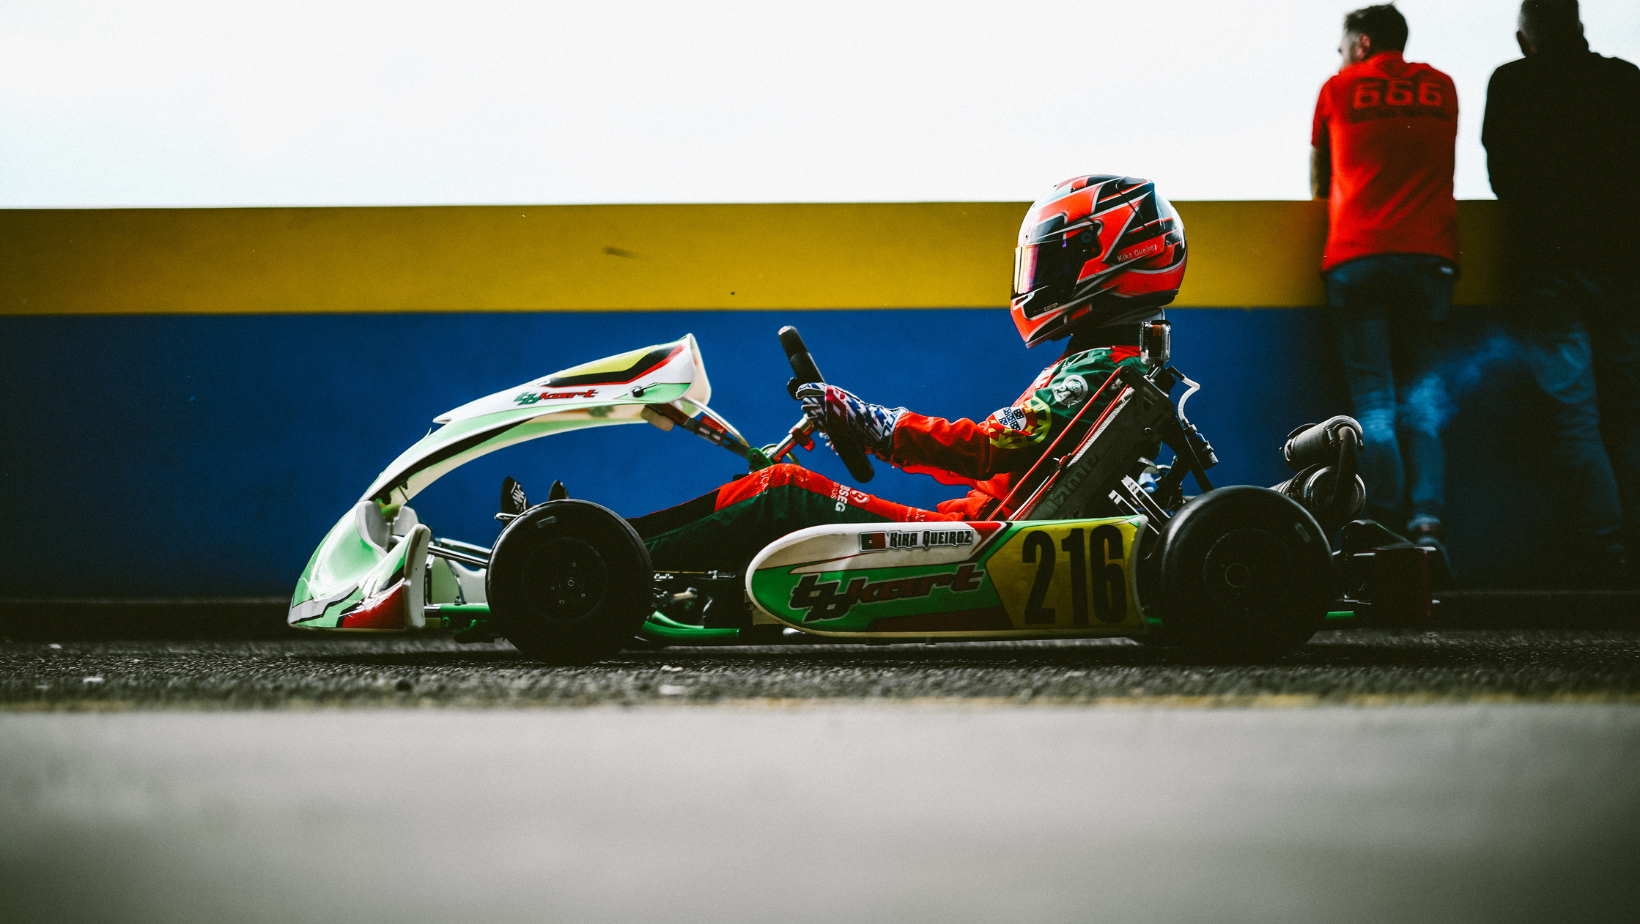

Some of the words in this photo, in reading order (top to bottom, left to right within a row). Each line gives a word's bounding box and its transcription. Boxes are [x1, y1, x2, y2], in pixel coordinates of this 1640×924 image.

[1352, 79, 1443, 110] 666
[889, 532, 917, 548] KIKA
[922, 530, 972, 548] QUEIROZ
[1022, 524, 1126, 626] 216
